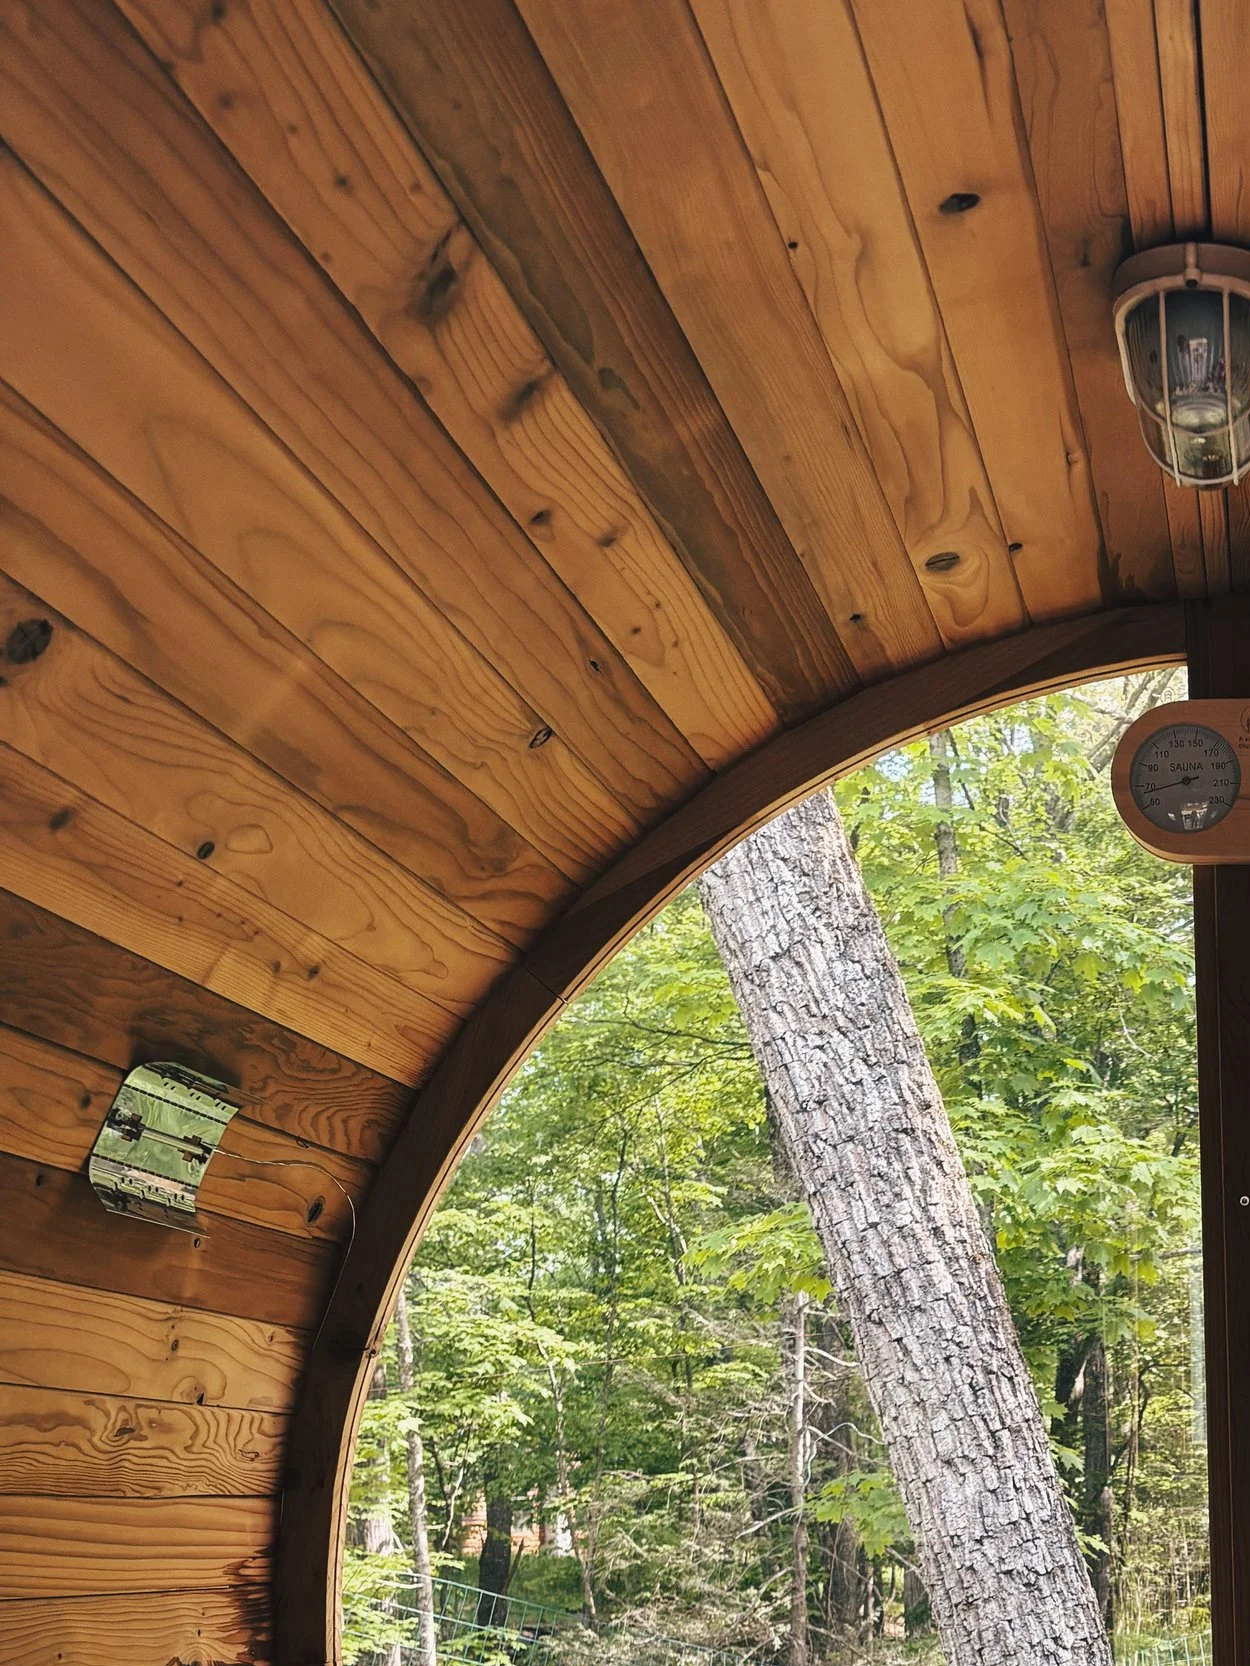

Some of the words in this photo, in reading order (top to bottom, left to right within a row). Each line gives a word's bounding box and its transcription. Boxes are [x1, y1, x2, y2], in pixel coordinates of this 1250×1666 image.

[1169, 740, 1185, 748] 130
[1188, 740, 1203, 748] 150
[1155, 750, 1169, 759] 110
[1203, 748, 1219, 757] 170
[1148, 764, 1159, 772] 90
[1169, 762, 1203, 772] SAUNA
[1211, 762, 1226, 770] 190
[1145, 782, 1156, 791] 70
[1213, 779, 1229, 787] 210
[1150, 797, 1160, 806] 50
[1208, 796, 1225, 804] 230
